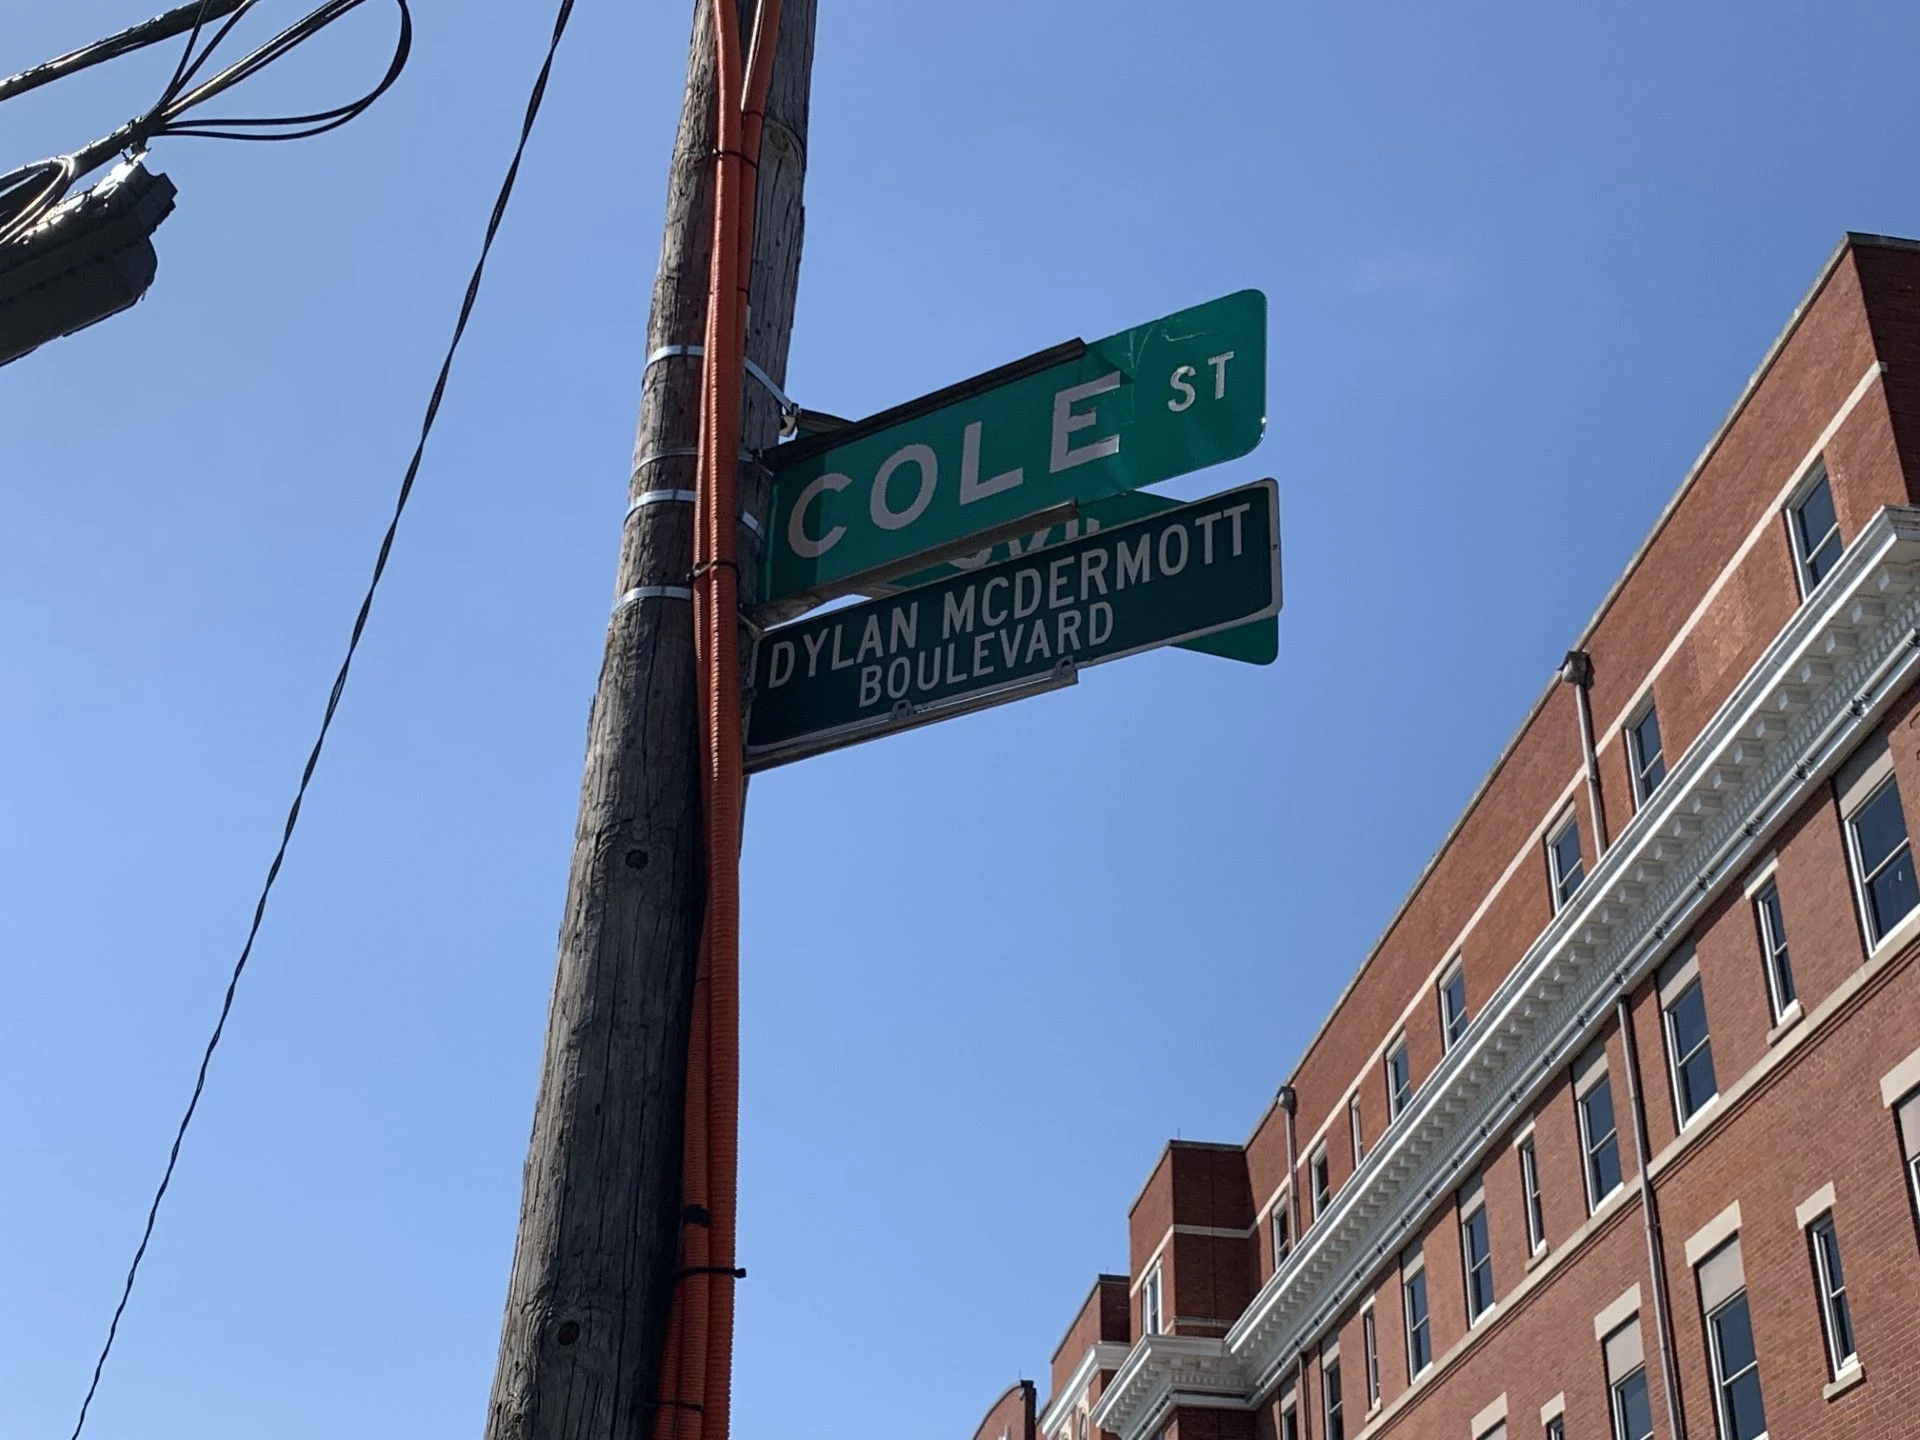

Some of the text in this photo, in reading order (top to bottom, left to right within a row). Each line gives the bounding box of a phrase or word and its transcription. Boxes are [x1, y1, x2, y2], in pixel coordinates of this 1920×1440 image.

[787, 371, 1120, 559] COLE
[1167, 351, 1234, 413] ST
[767, 601, 918, 689] DYLAN
[942, 503, 1251, 640] MCDERMOTT
[858, 601, 1114, 708] BOULEVARD
